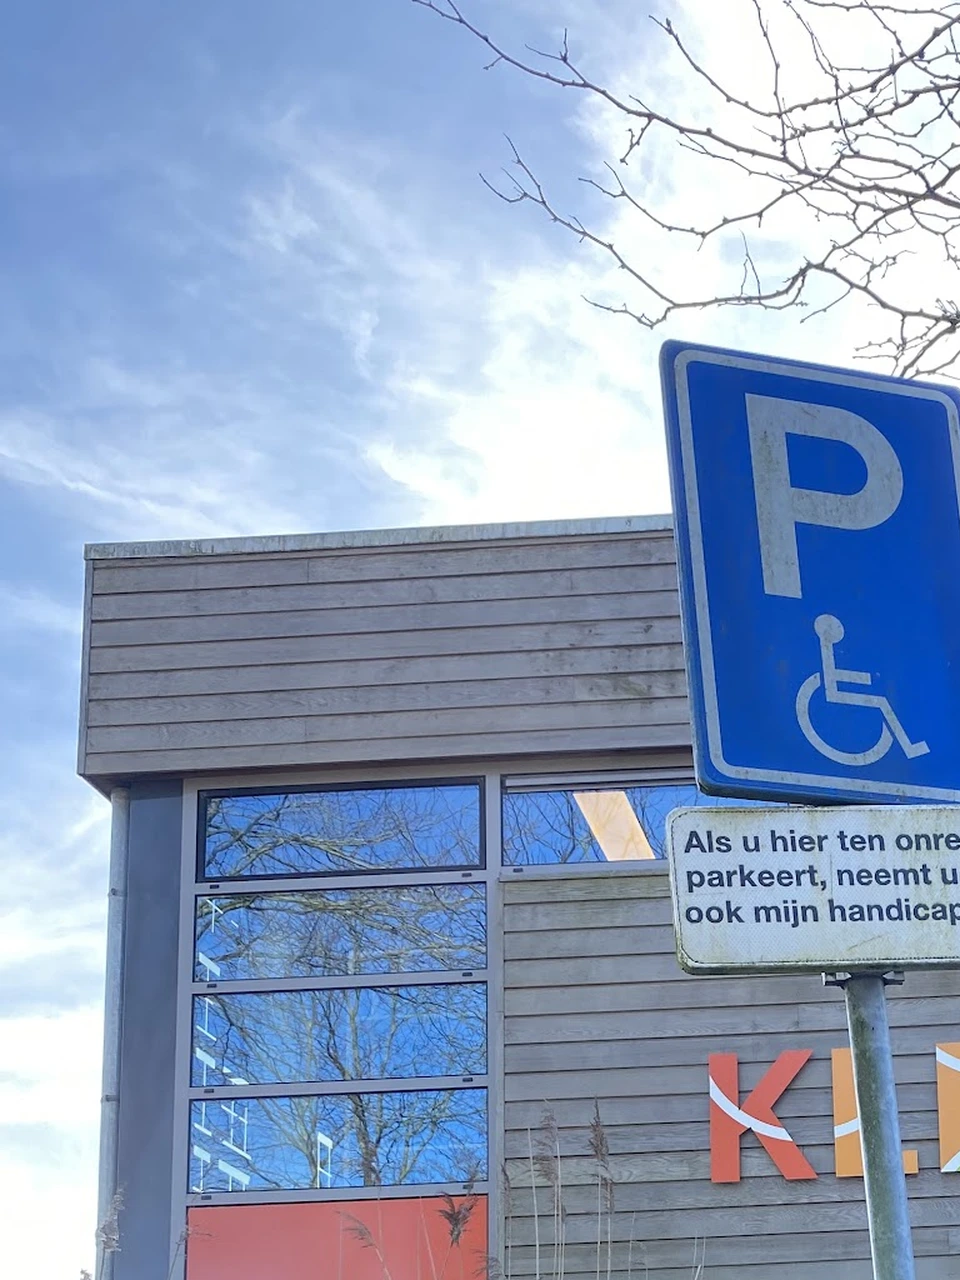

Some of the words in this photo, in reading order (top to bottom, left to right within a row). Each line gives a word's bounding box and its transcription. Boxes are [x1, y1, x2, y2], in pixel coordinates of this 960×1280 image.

[745, 393, 903, 599] P
[684, 830, 732, 853] Als
[743, 836, 760, 852] u
[771, 830, 828, 852] hier
[837, 831, 885, 851] ten
[686, 865, 827, 892] parkeert,
[837, 864, 931, 885] neemt
[941, 868, 958, 884] u
[685, 901, 745, 923] ook
[754, 900, 818, 928] mijn
